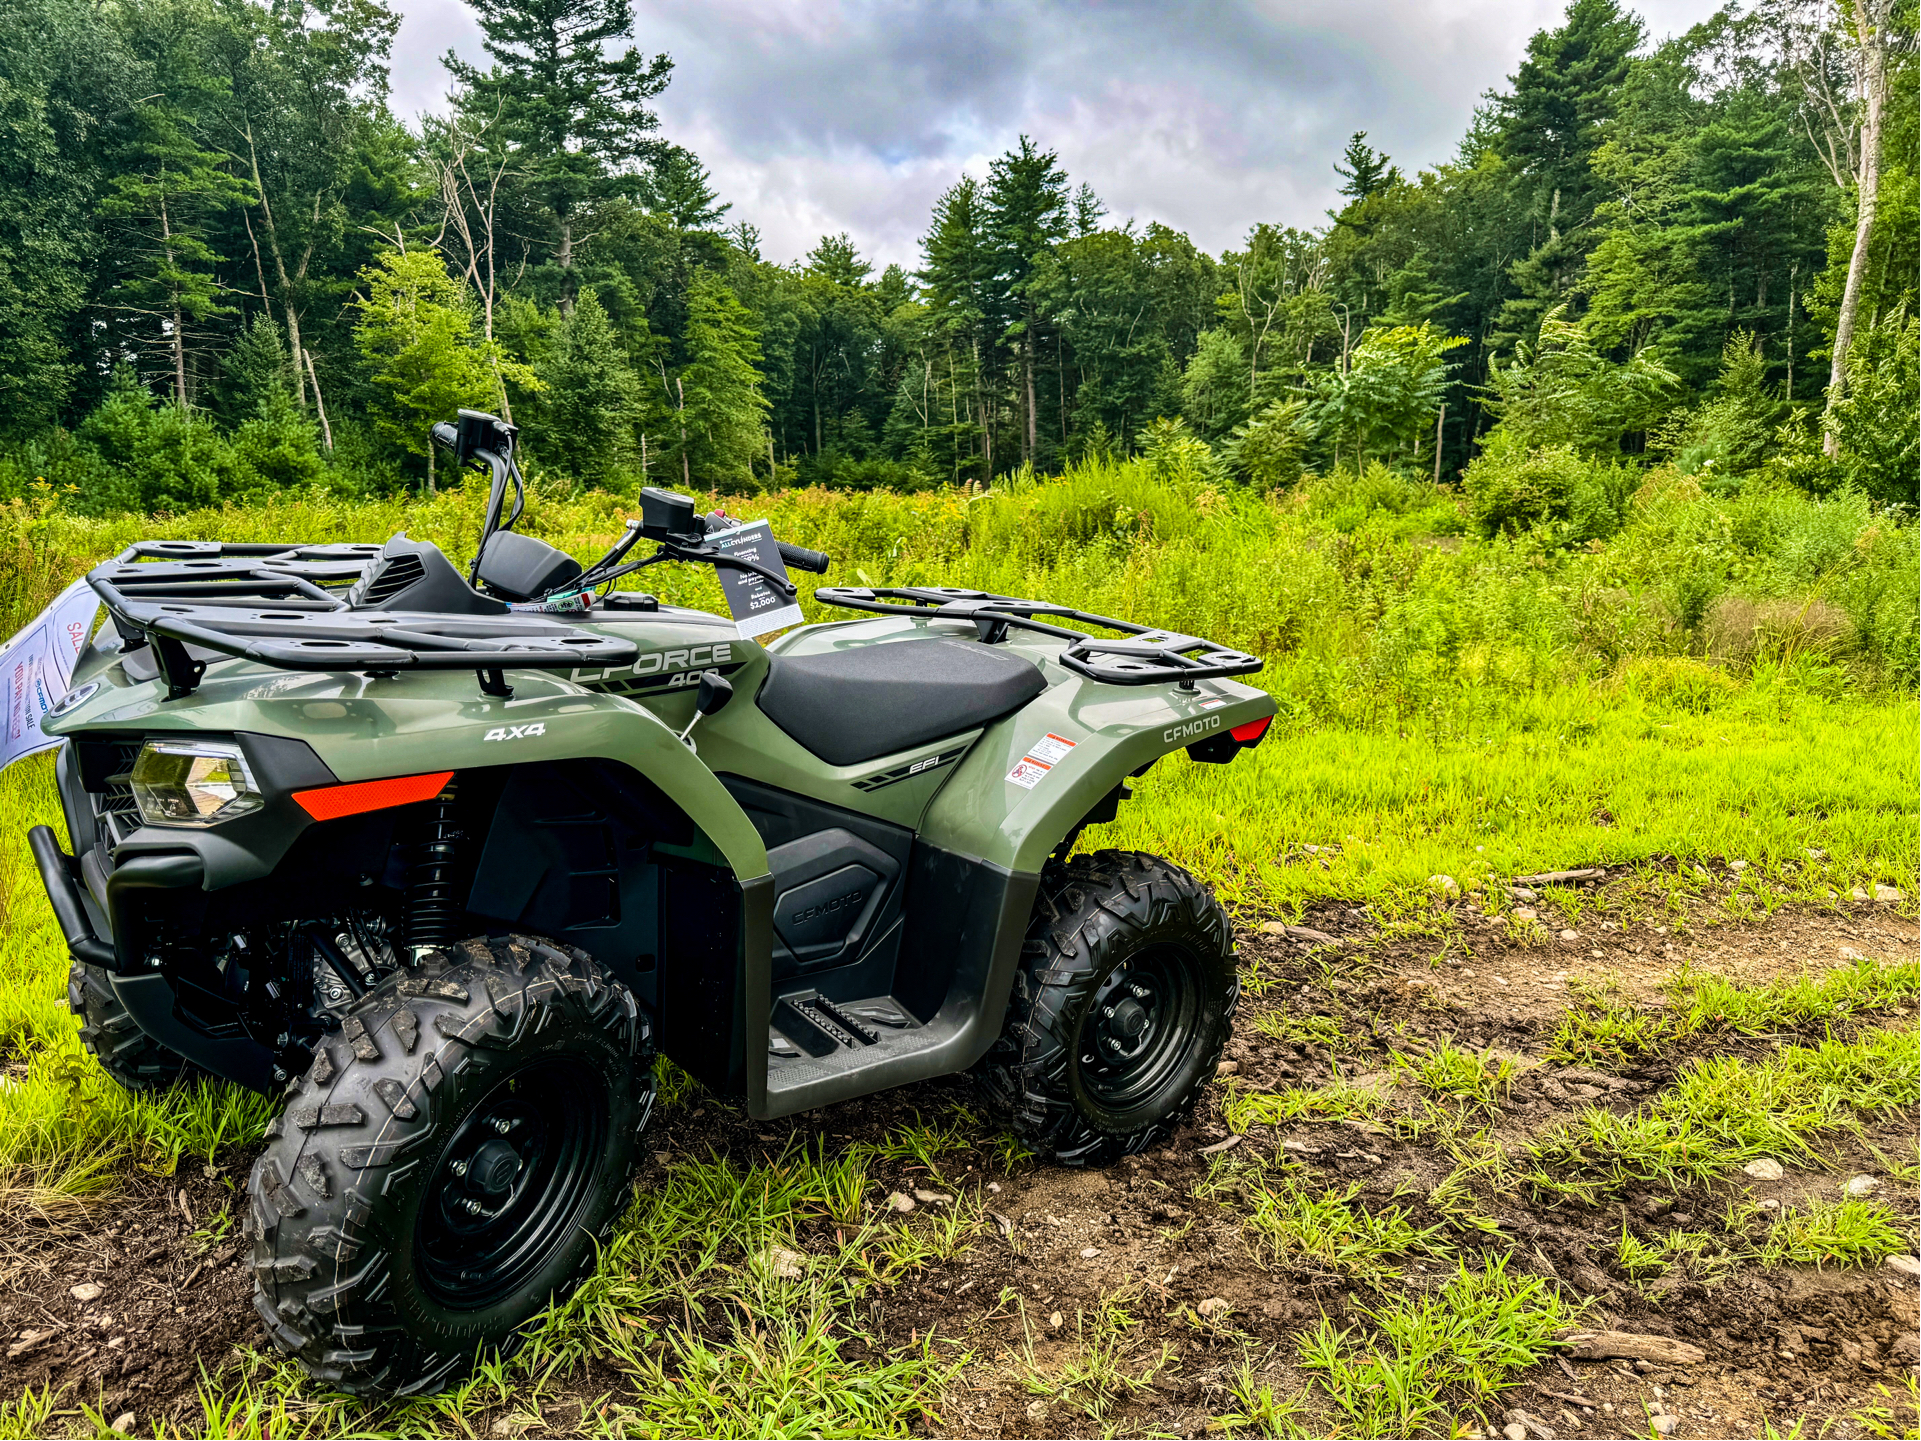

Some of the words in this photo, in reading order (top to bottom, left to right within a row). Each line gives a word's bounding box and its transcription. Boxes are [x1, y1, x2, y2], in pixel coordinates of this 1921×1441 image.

[733, 547, 757, 557] Financing
[750, 596, 776, 610] $2,000
[15, 661, 24, 685] YOU
[15, 681, 23, 702] PAY
[13, 698, 21, 717] NO
[25, 713, 36, 730] SALE
[1163, 715, 1220, 743] CFMOTO
[909, 756, 940, 774] EFI
[792, 890, 862, 926] CFMOTO
